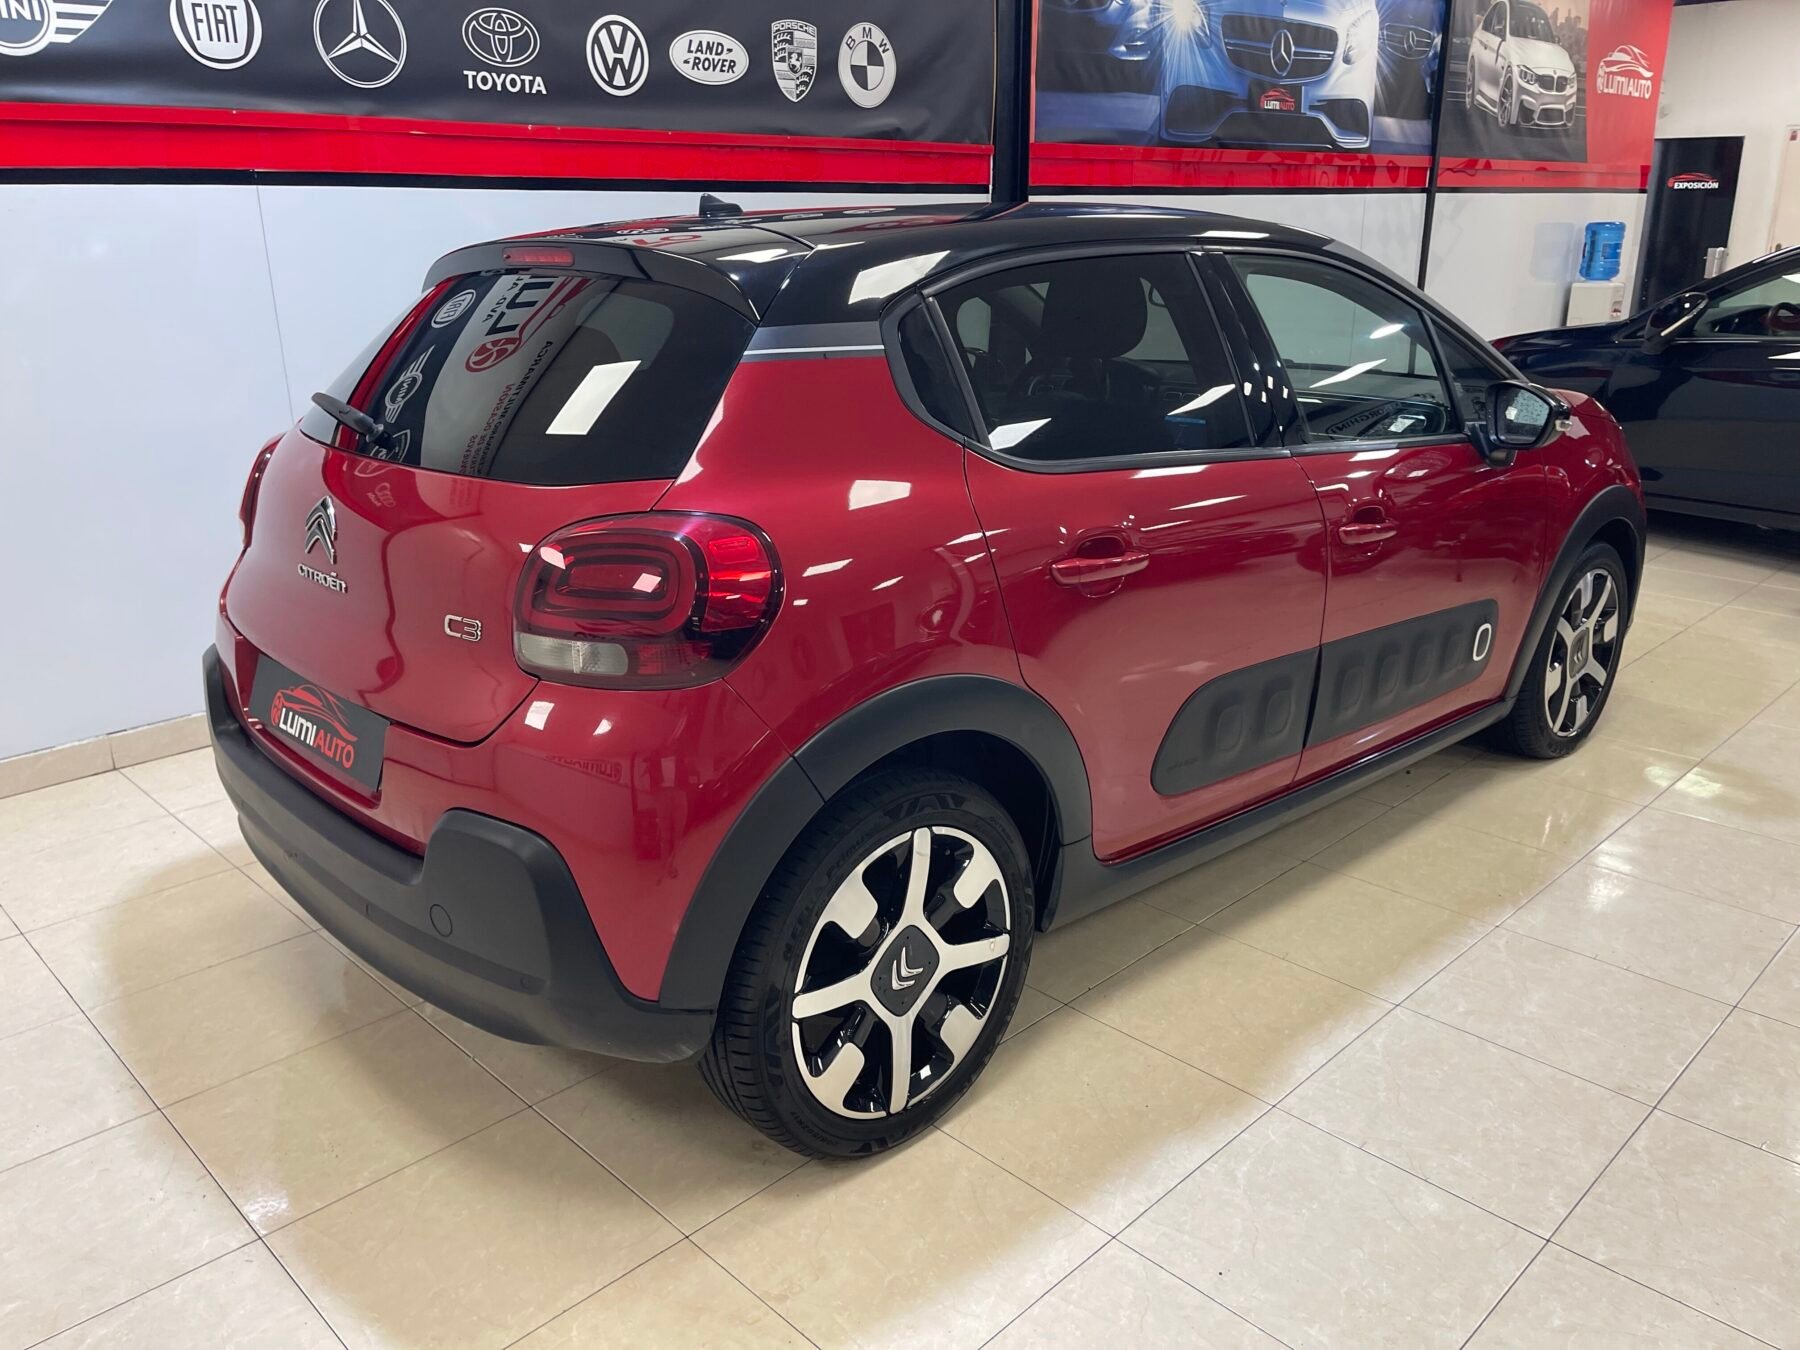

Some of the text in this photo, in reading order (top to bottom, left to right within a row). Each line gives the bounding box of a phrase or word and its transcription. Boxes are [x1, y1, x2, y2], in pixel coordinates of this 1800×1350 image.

[0, 0, 42, 21] INI
[191, 2, 238, 43] FIAT
[773, 21, 816, 37] PORSCHE
[845, 26, 890, 54] BMW
[687, 39, 726, 56] LAND
[691, 57, 737, 74] ROVER
[463, 70, 547, 94] TOYOTA
[1602, 73, 1653, 99] LUMIAUTO
[1673, 179, 1719, 190] EXPOSICIÓN
[444, 614, 482, 642] C3
[279, 707, 355, 769] LUMIAUTO
